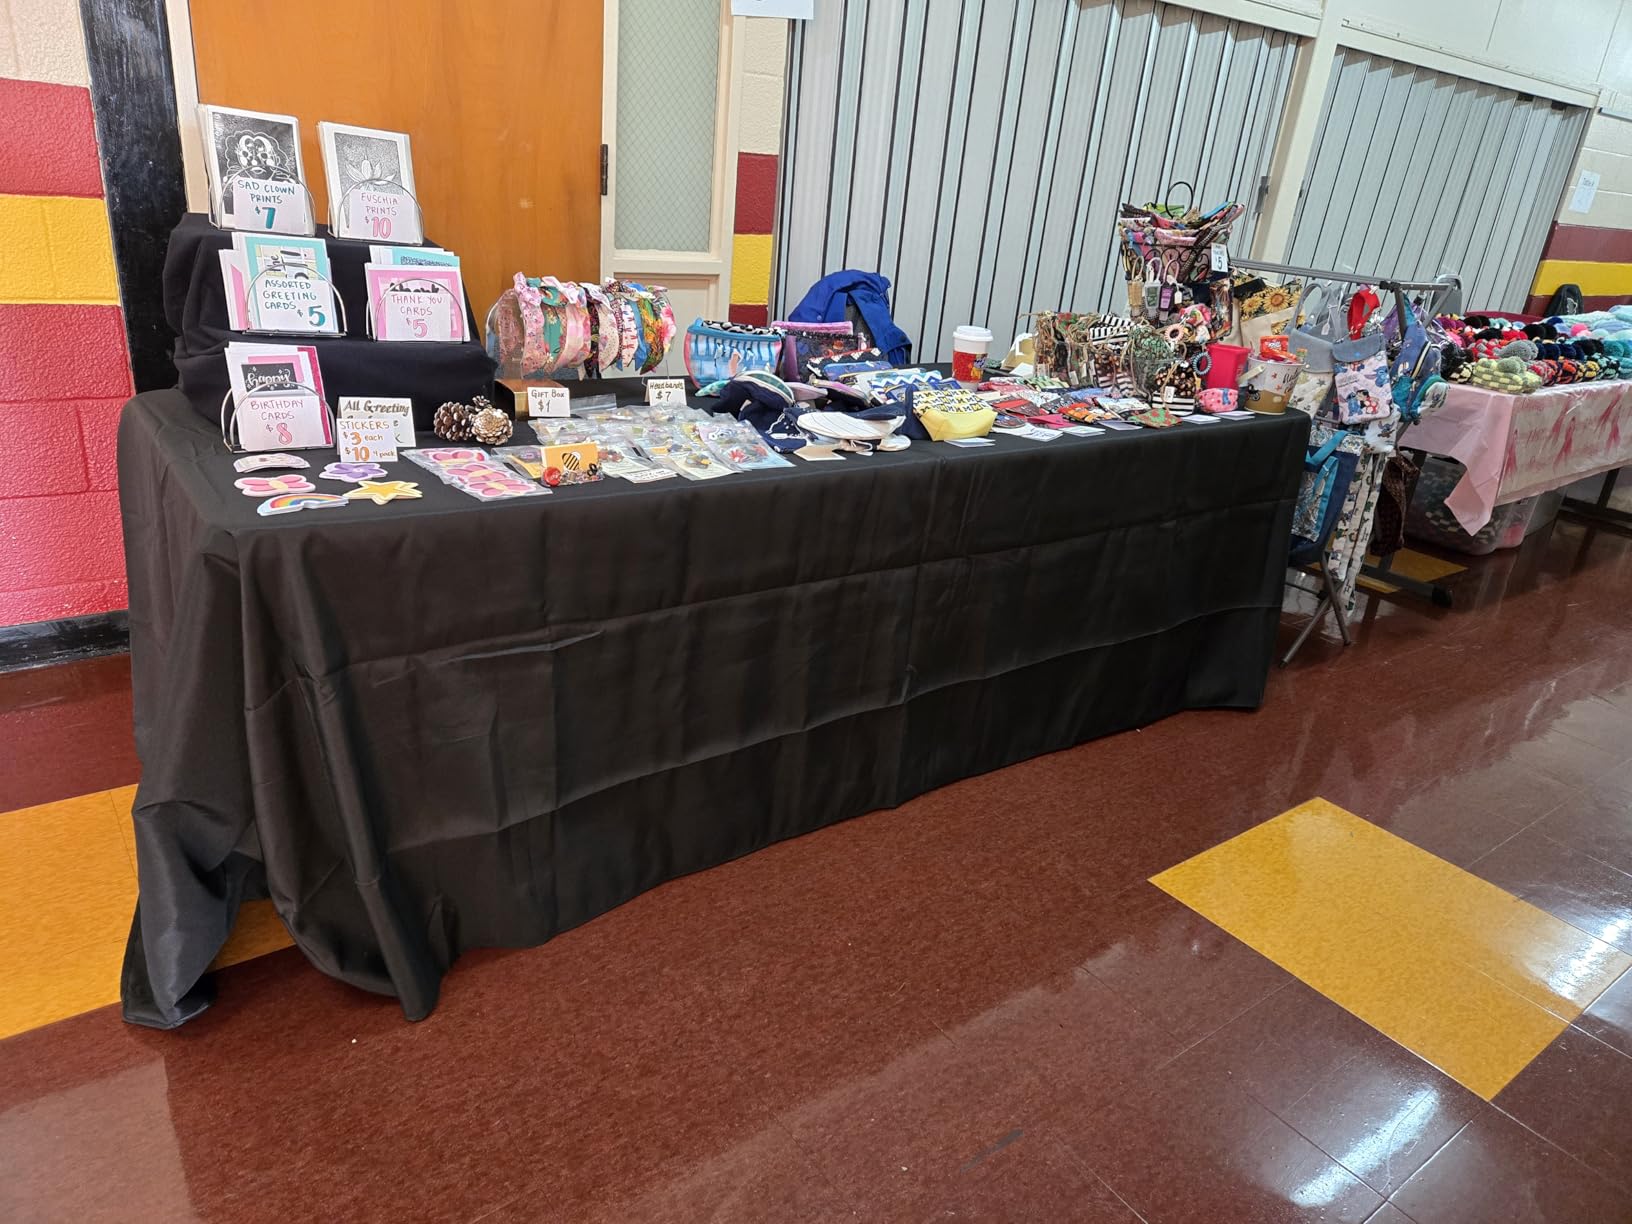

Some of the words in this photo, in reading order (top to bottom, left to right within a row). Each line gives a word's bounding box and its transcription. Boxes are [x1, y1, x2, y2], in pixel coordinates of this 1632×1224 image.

[237, 179, 260, 190] SAD
[264, 183, 296, 195] CLOWN
[251, 193, 283, 204] PRINTS
[361, 193, 398, 205] FUSCHIA
[366, 205, 397, 216] PRINTS
[365, 215, 392, 239] $10
[265, 280, 311, 290] ASSORTED
[263, 290, 317, 301] GREETING
[391, 294, 423, 304] THANK
[427, 295, 443, 303] YOU
[264, 301, 297, 311] CARDS
[400, 306, 433, 316] CARDS
[246, 369, 291, 388] happy
[250, 399, 304, 410] BIRTHDAY
[343, 400, 360, 411] All
[364, 400, 409, 417] Greeting
[261, 410, 295, 421] CARDS
[339, 420, 390, 430] STICKERS
